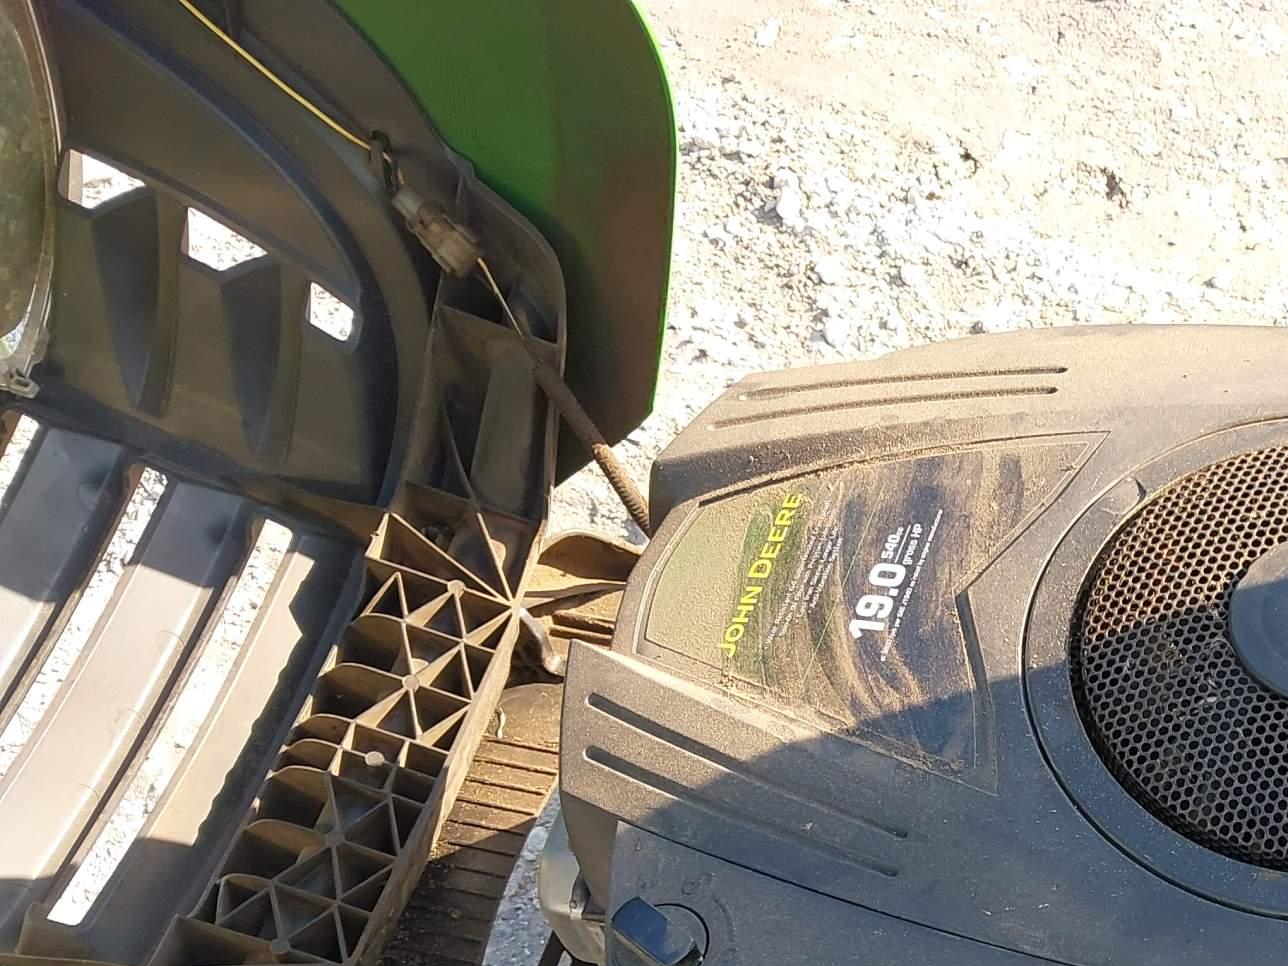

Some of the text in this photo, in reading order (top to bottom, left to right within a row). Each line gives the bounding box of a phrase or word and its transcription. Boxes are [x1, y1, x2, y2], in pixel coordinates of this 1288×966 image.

[718, 491, 804, 657] JOHN DEERE
[903, 522, 925, 567] gross HP
[849, 562, 907, 638] 19.0
